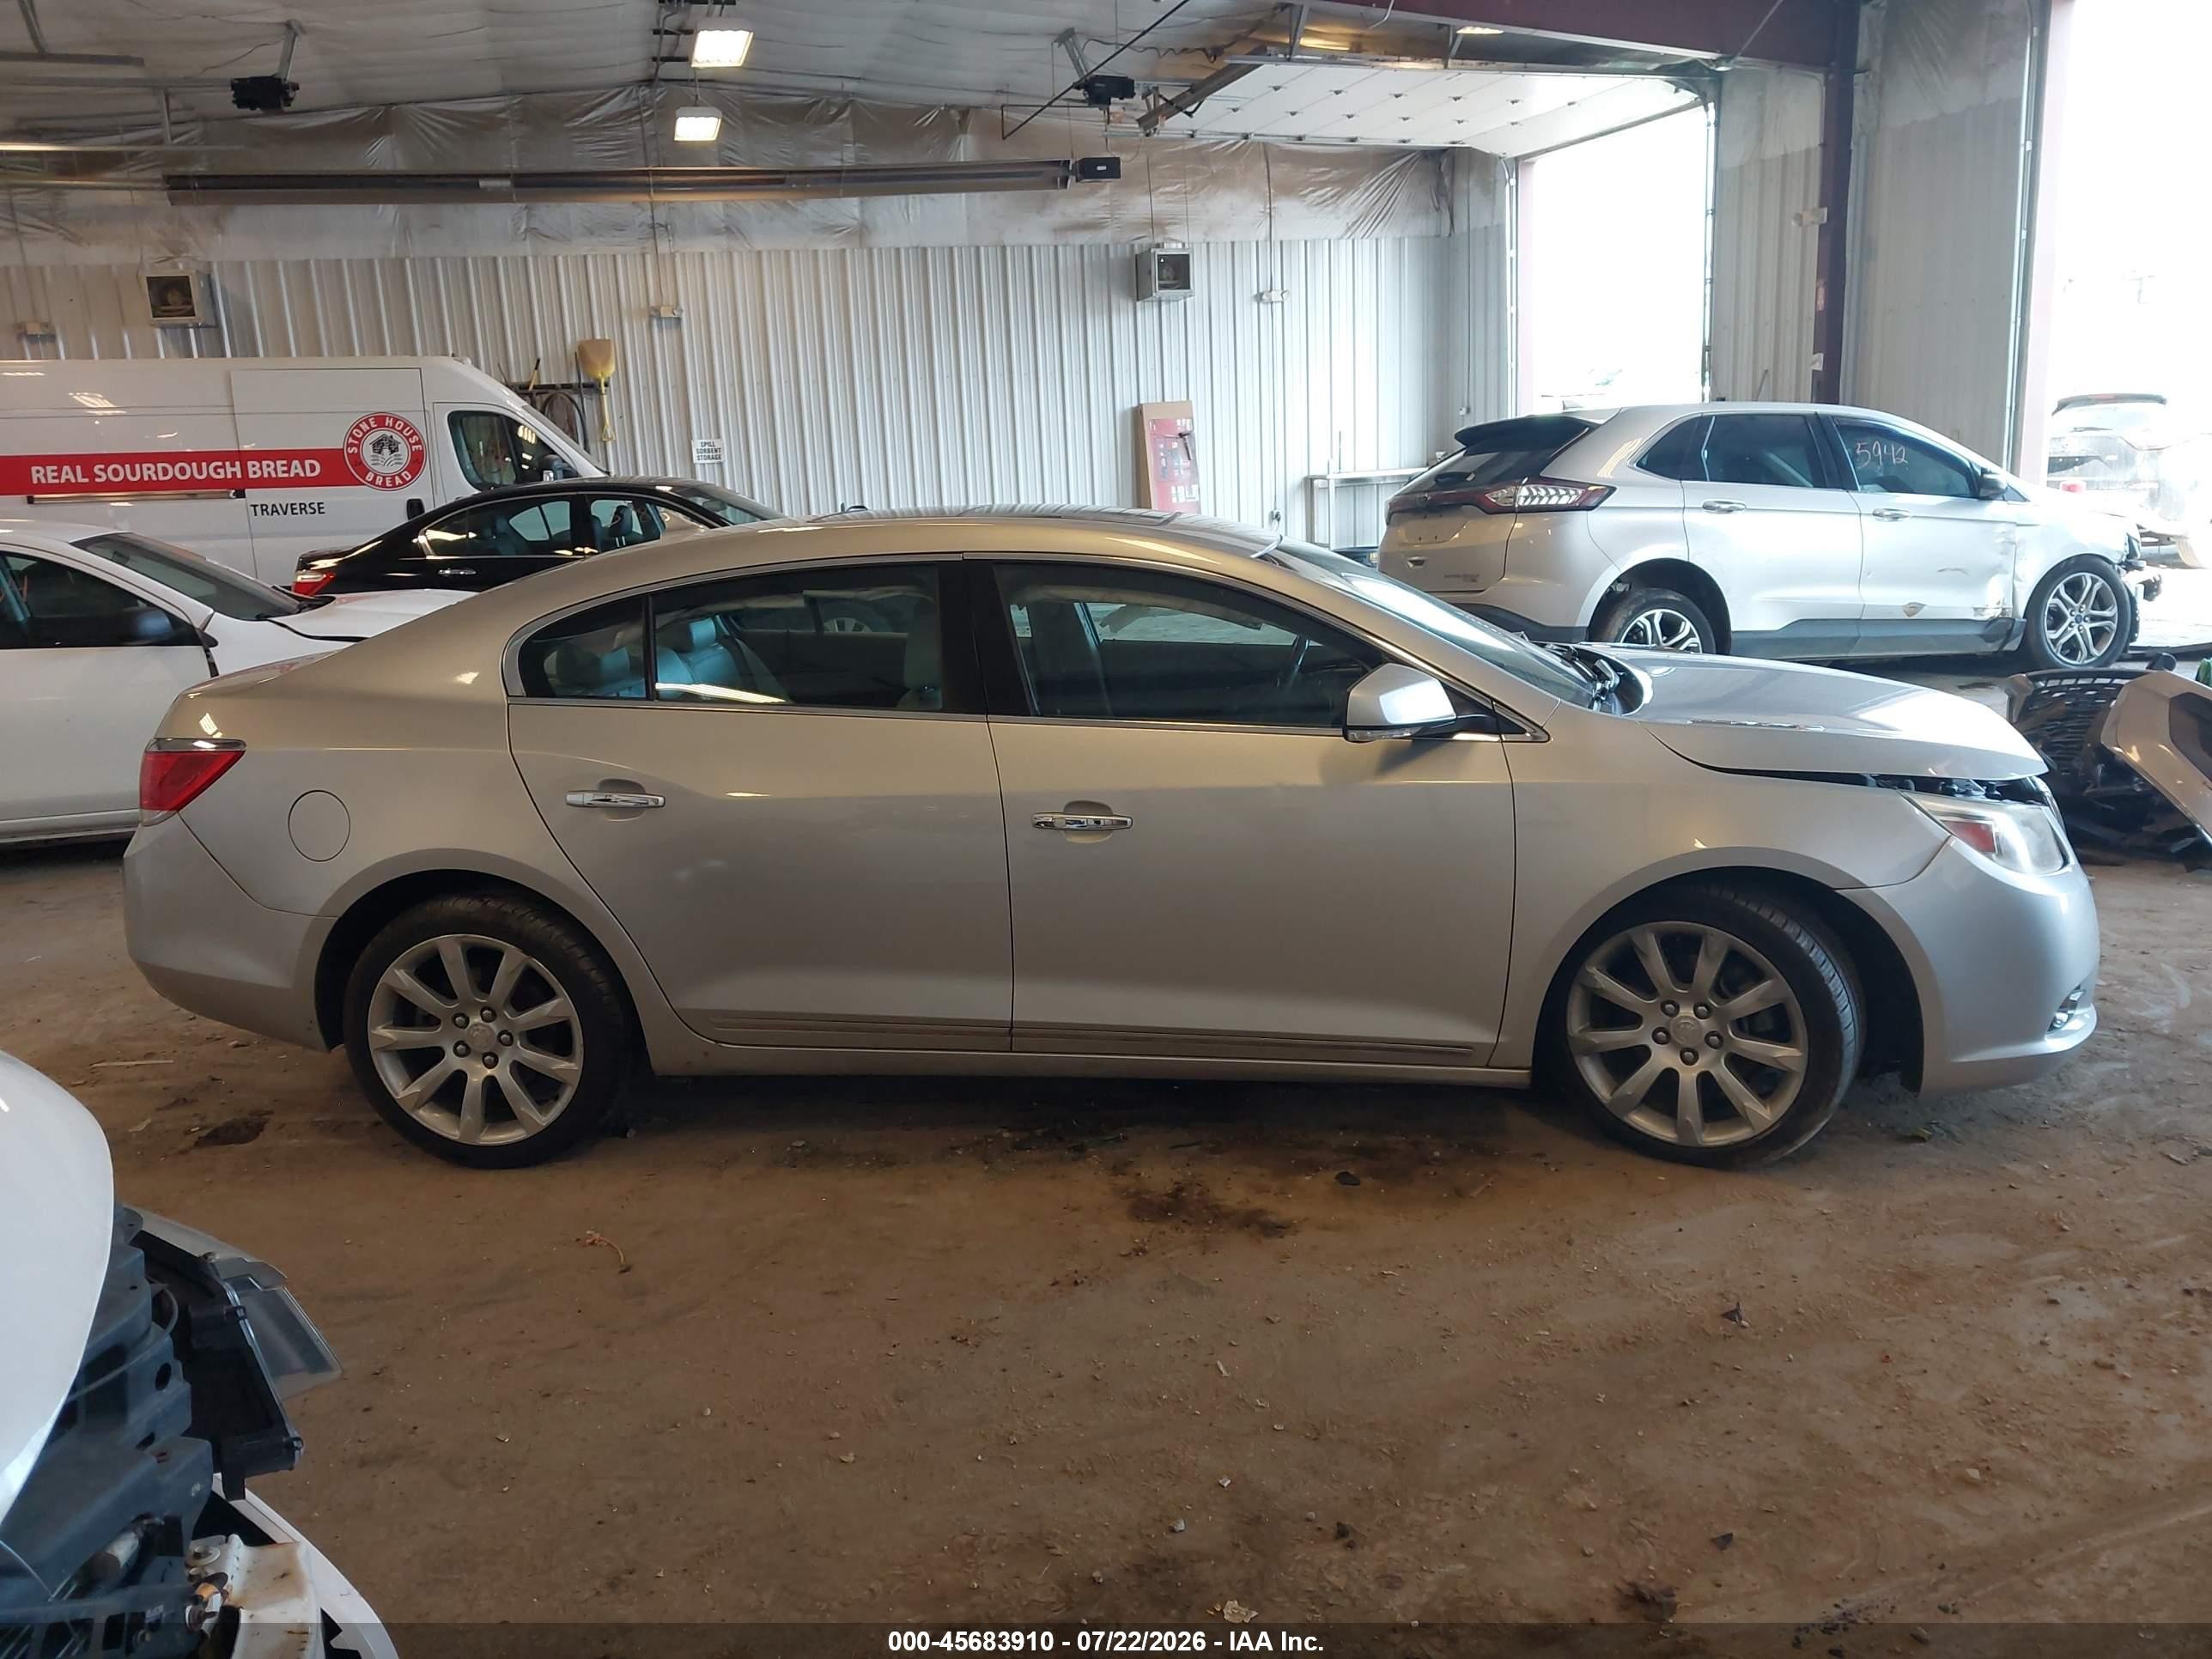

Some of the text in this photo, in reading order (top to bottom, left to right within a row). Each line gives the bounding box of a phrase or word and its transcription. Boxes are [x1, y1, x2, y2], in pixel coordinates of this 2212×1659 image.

[348, 416, 422, 454] STONE HOUSE
[1856, 441, 1908, 469] 5942
[31, 459, 321, 484] REAL SOURDOUGH BREAD
[365, 470, 412, 487] BREAD
[250, 501, 325, 516] TRAVERSE
